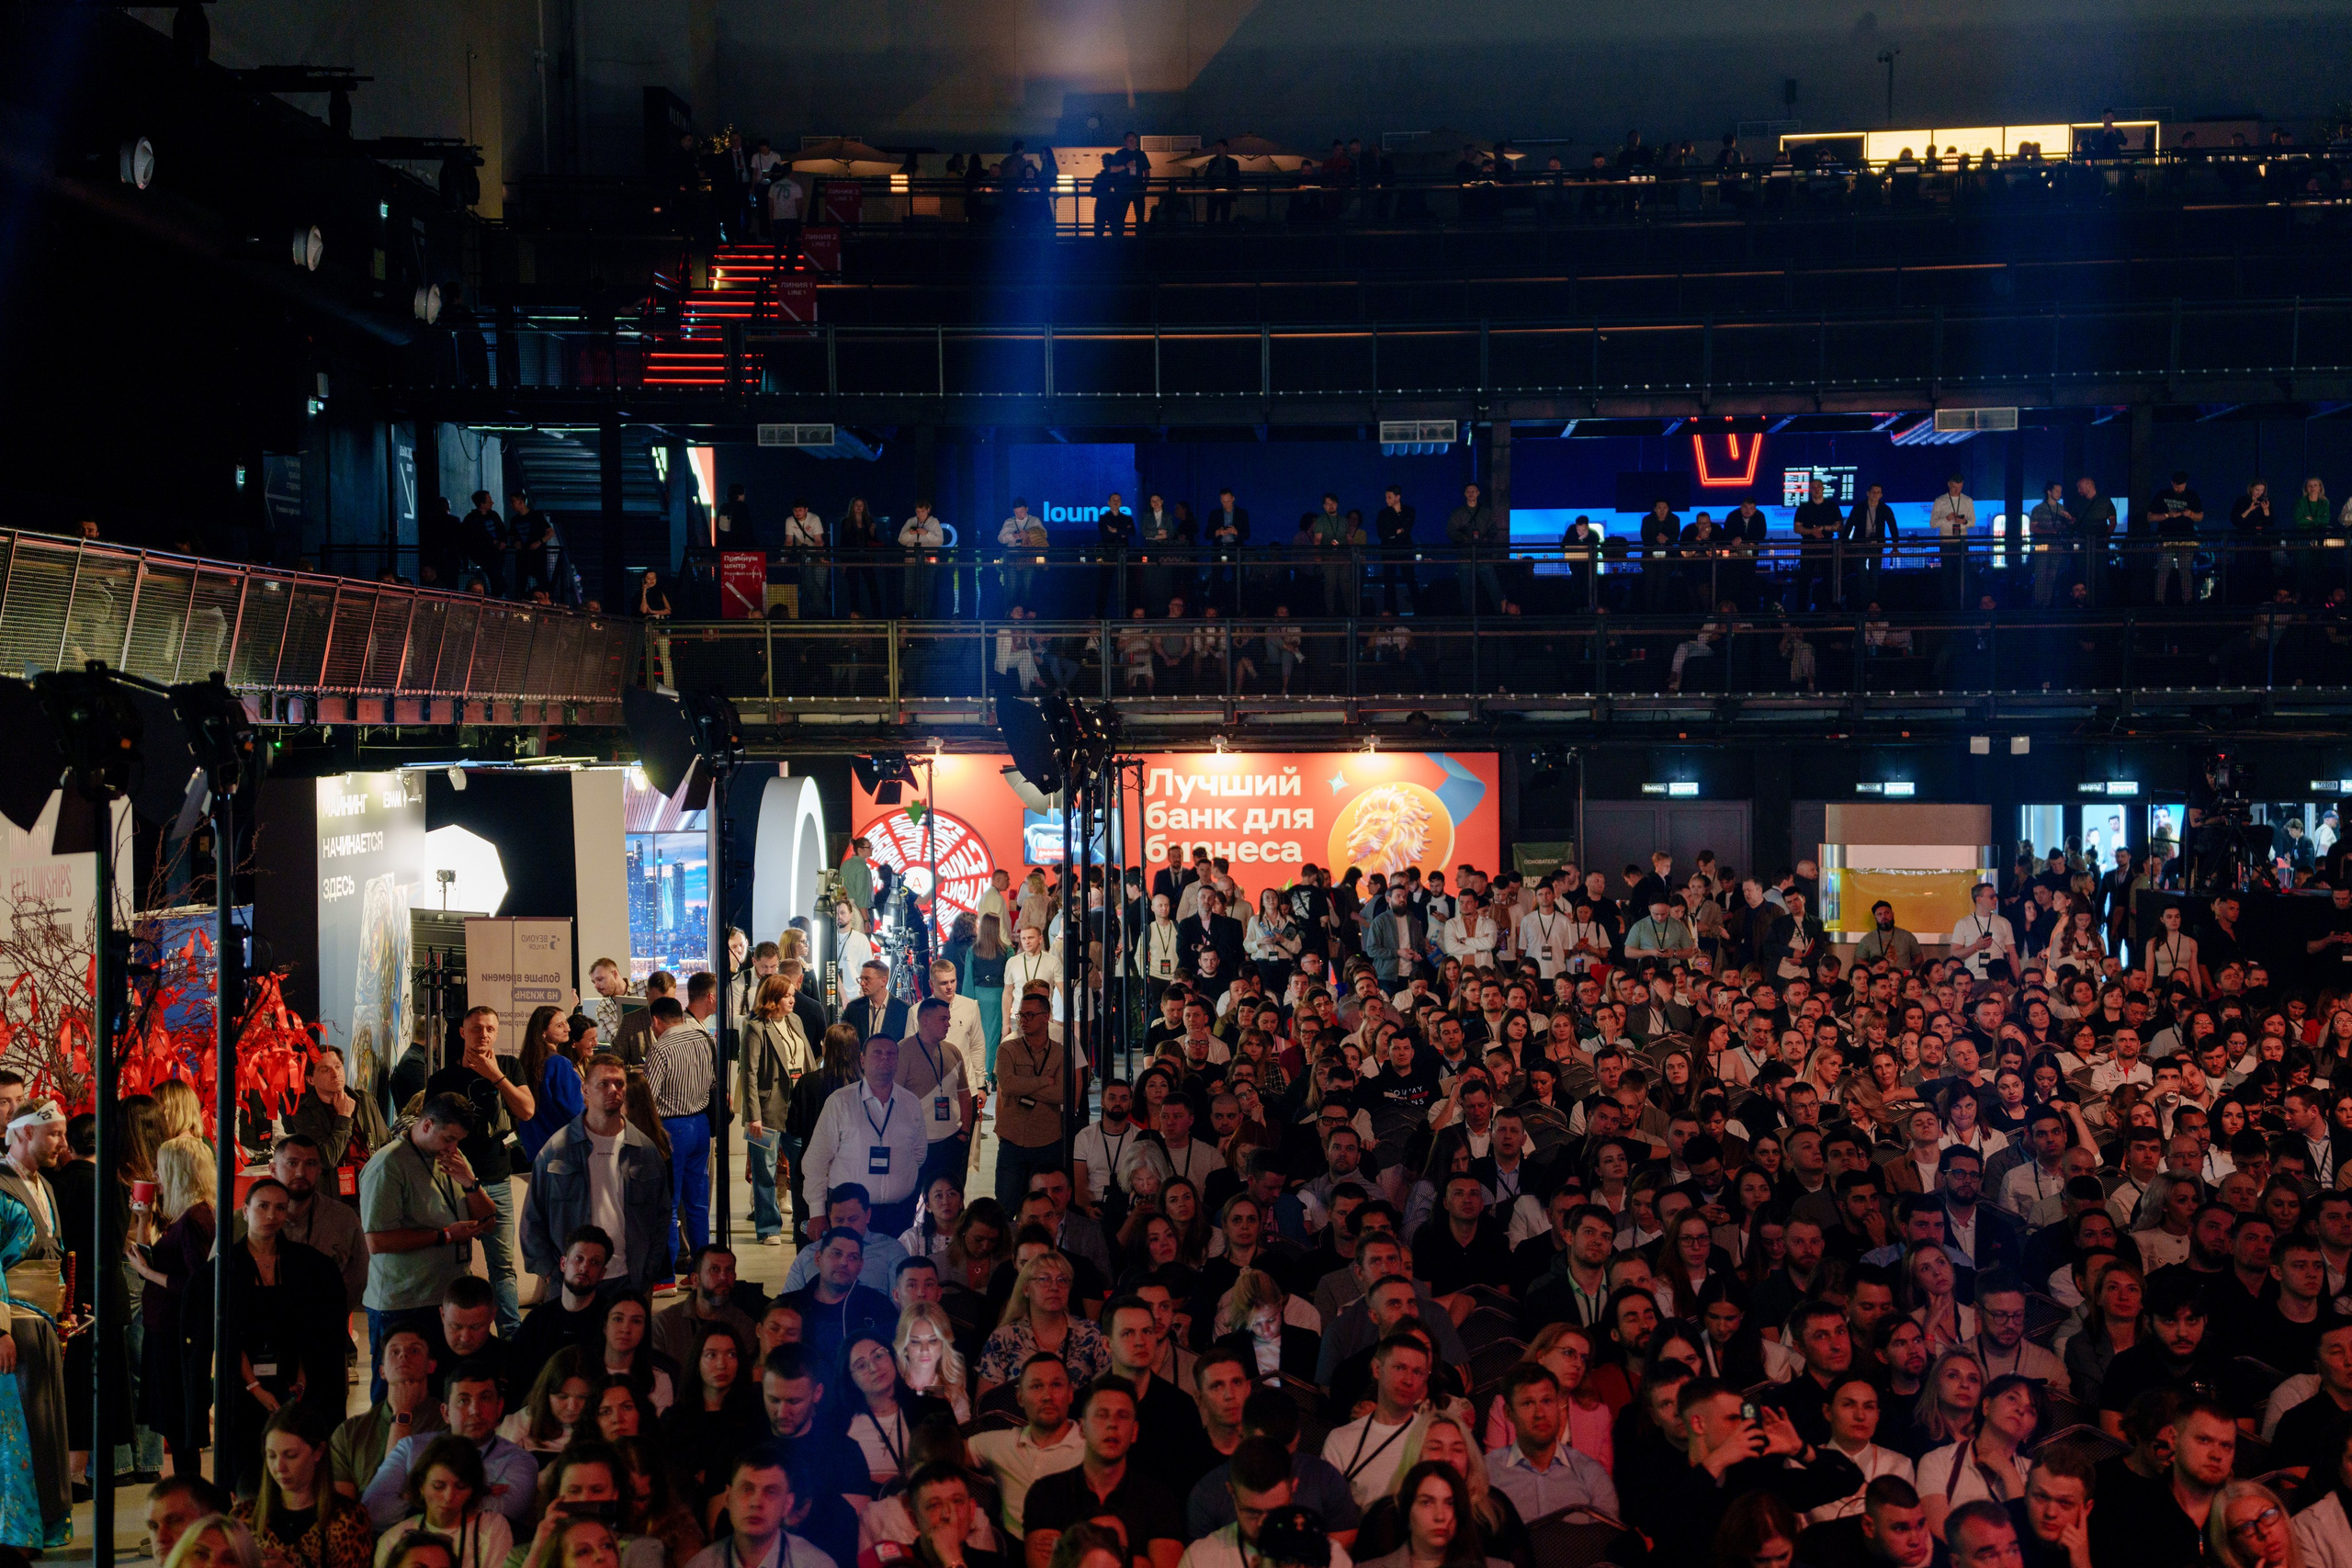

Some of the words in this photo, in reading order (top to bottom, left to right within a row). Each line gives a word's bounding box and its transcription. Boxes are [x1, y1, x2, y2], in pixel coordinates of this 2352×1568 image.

[805, 233, 831, 242] ЛИНИЯ
[833, 233, 838, 242] 2
[780, 281, 808, 289] ЛИНИЯ
[1043, 501, 1132, 523] loun
[723, 555, 758, 563] Премиум
[1145, 766, 1301, 804] Лучший
[322, 789, 368, 818] МАЙНИНГ
[1145, 800, 1238, 829] банк
[1243, 807, 1314, 835] для
[322, 830, 383, 859] НАЧИНАЕТСЯ
[937, 839, 988, 880] СТИЛЬ
[10, 863, 72, 903] FELLOWSHIPS
[322, 874, 356, 903] ЗДЕСЬ
[826, 960, 836, 983] LIGHT
